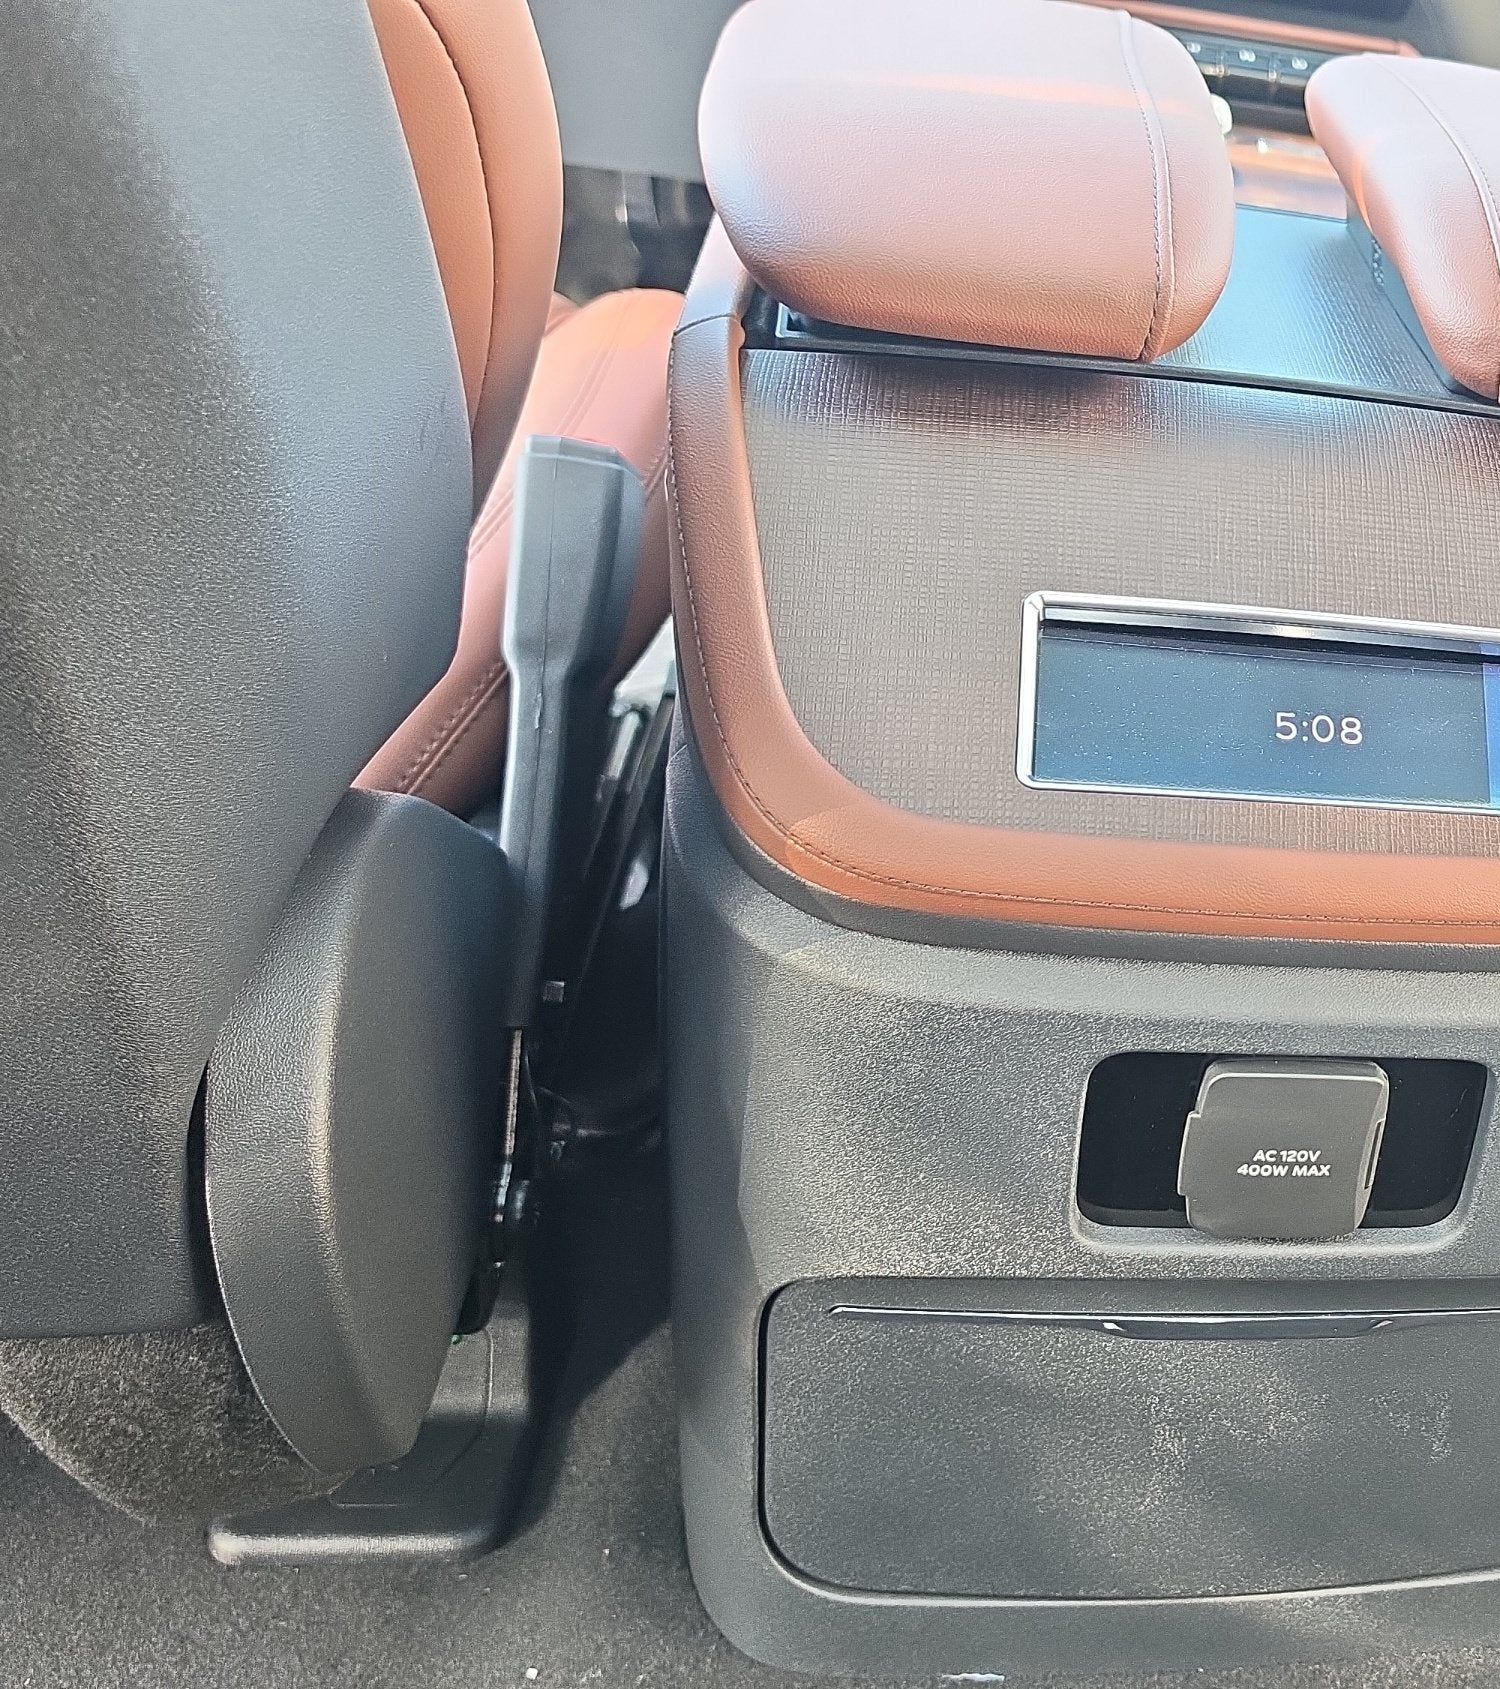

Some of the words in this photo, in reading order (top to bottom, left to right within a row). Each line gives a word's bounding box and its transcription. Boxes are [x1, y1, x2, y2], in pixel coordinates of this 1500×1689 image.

[1275, 711, 1363, 745] 5:08
[1252, 1149, 1278, 1162] AC
[1279, 1150, 1321, 1163] 120V
[1236, 1163, 1289, 1177] 400W
[1291, 1164, 1331, 1177] MAX
